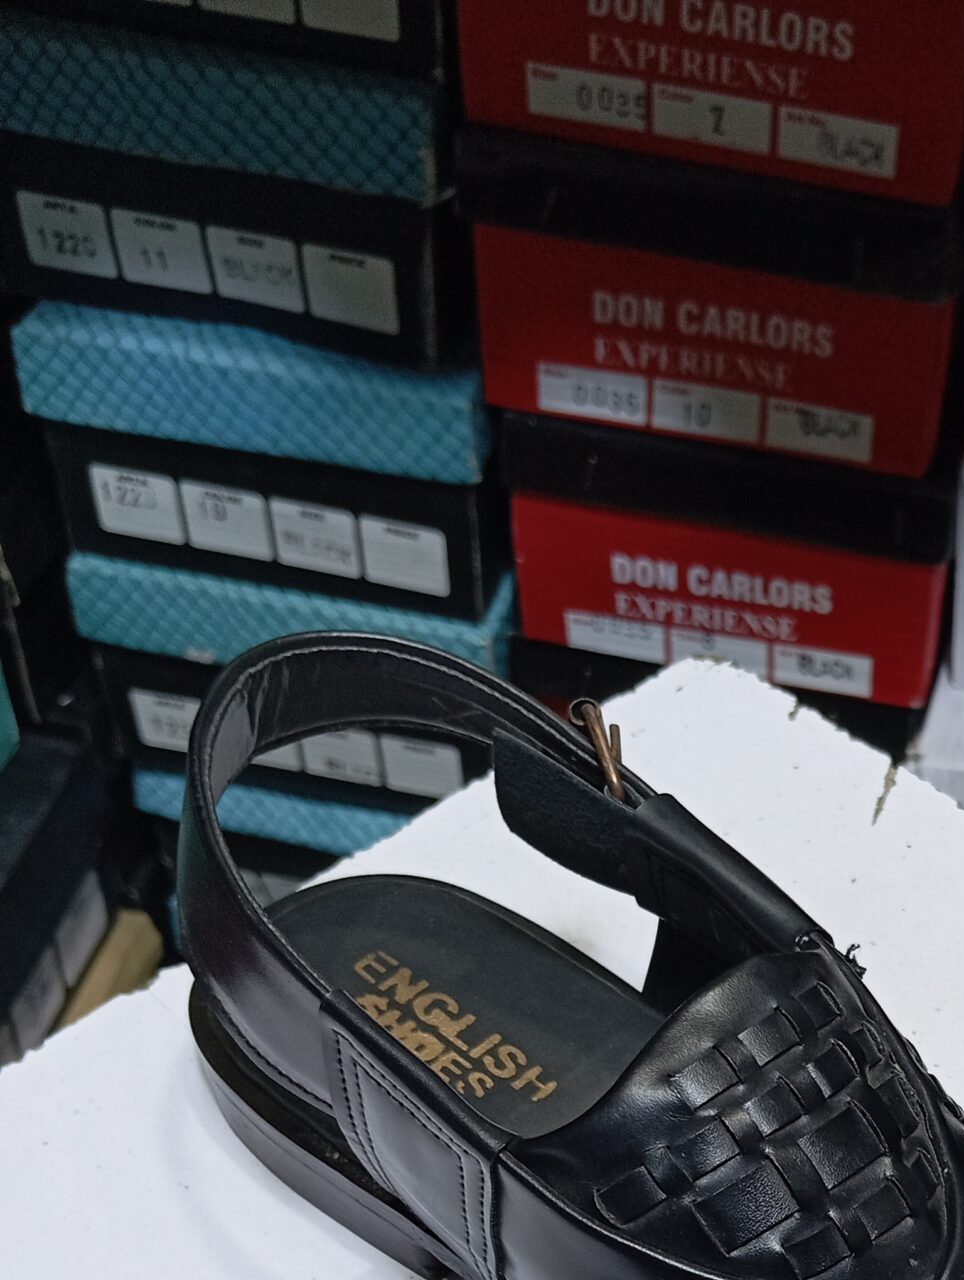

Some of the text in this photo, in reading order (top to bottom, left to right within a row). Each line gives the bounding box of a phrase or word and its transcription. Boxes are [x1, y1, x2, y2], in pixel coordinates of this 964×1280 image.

[680, 0, 855, 61] CARLORS
[589, 32, 810, 99] EXPERIENSE
[593, 289, 835, 359] DON CARLORS
[609, 550, 833, 616] DON CARLORS
[614, 591, 799, 643] EXPERIENSE
[353, 950, 558, 1102] ENGLISH
